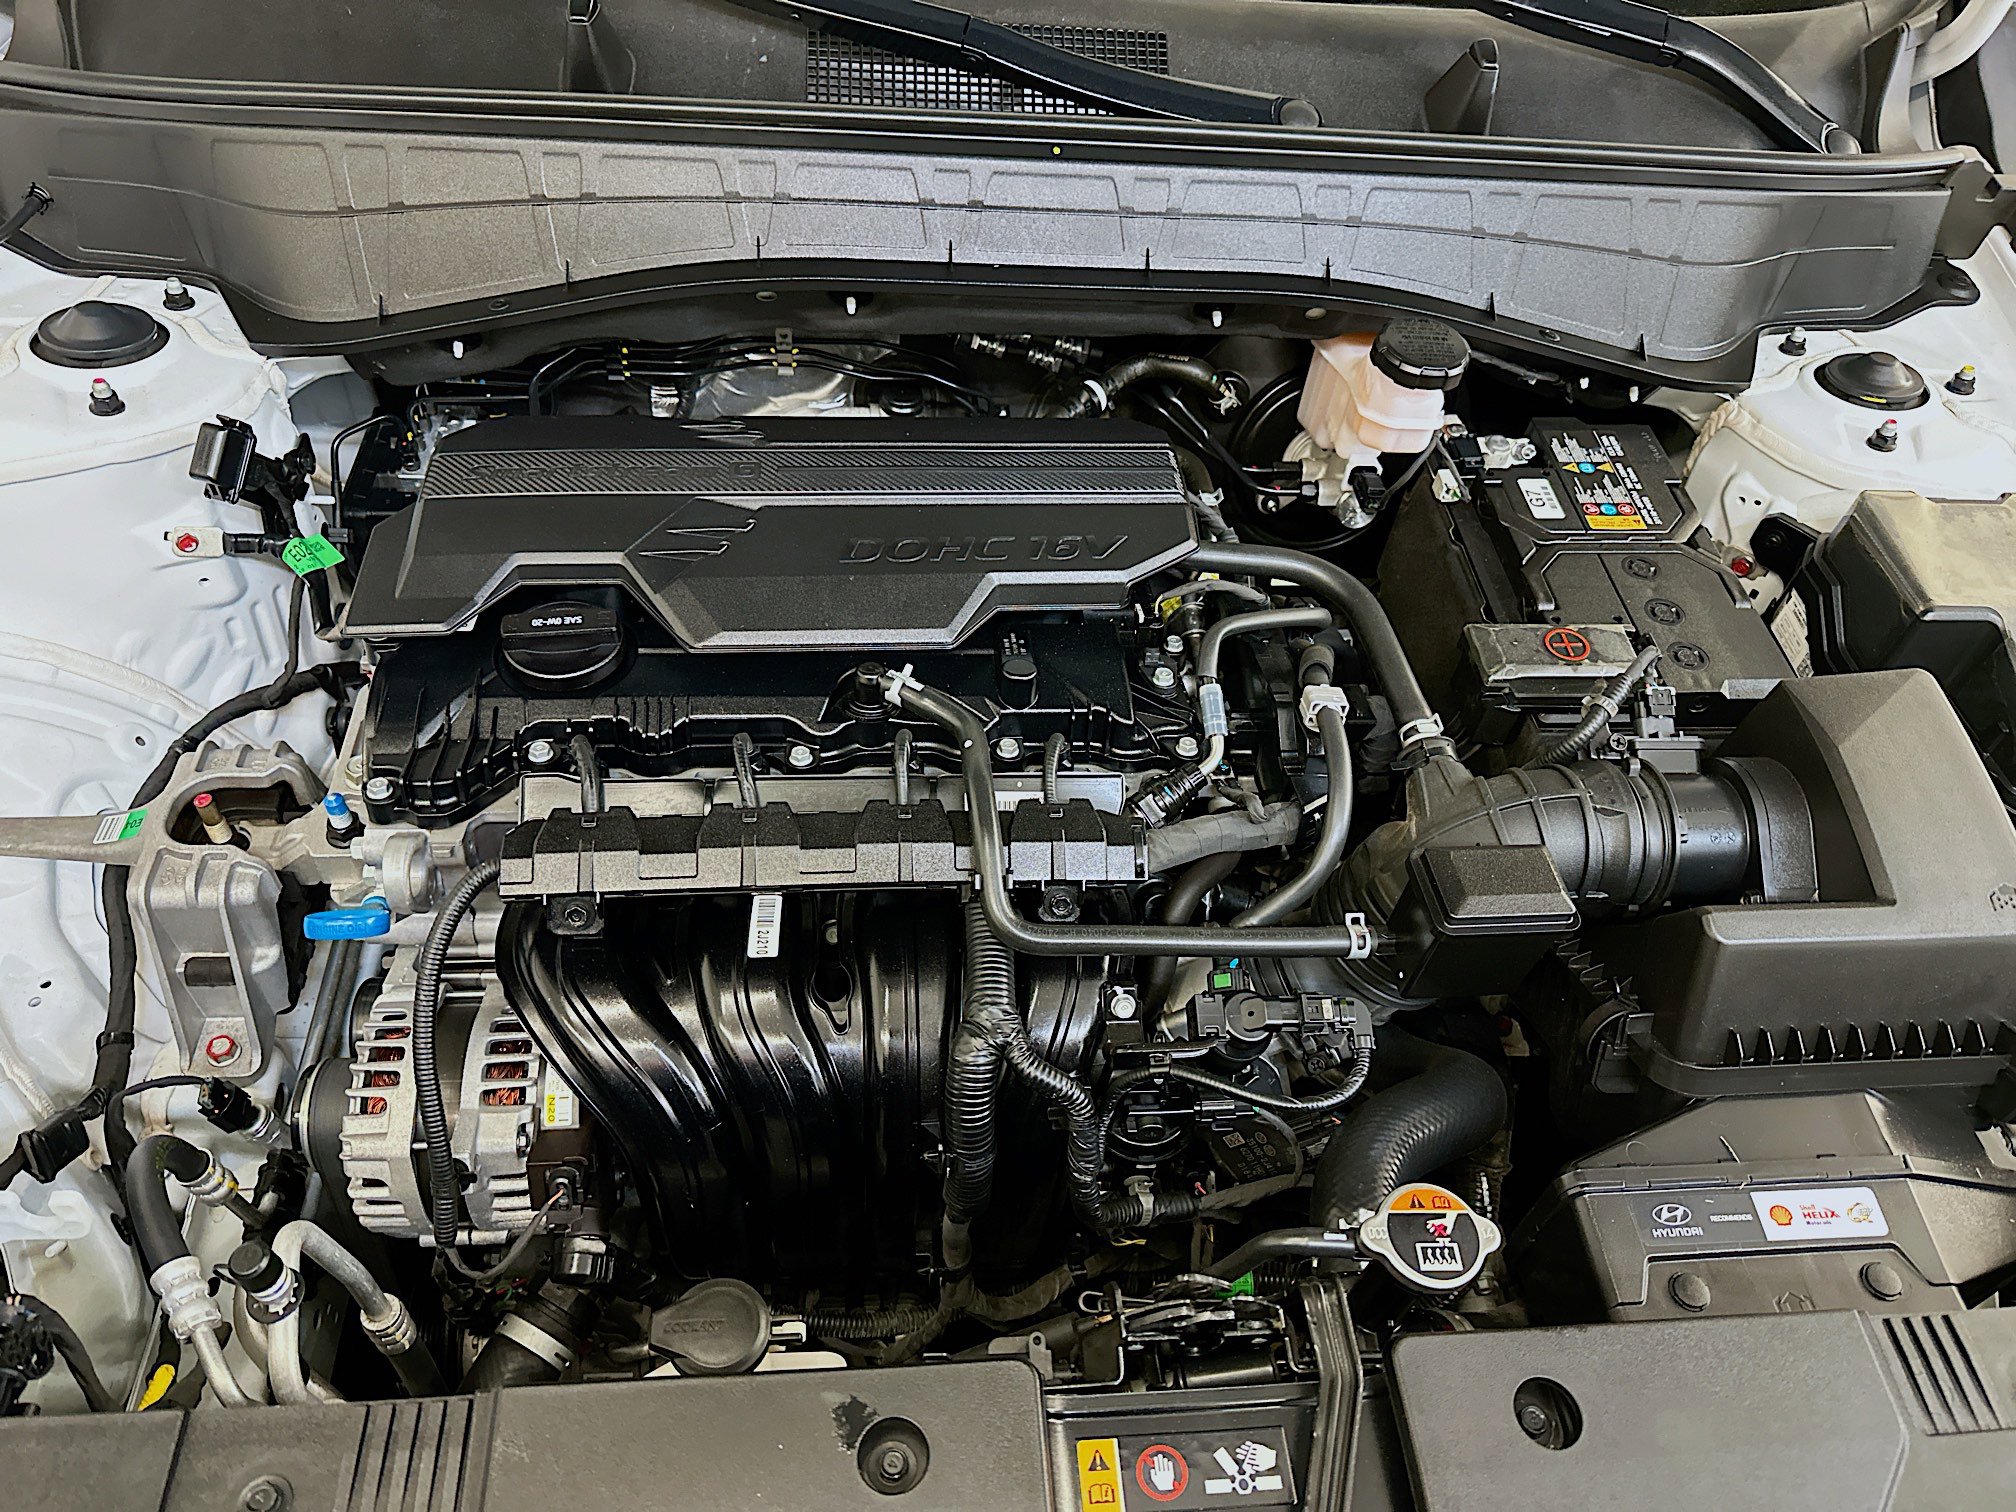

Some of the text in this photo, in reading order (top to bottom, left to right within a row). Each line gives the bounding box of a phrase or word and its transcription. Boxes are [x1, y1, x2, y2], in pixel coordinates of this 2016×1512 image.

[839, 534, 1129, 563] DOHC 16V
[531, 615, 583, 627] SAE 0W-20
[310, 923, 345, 935] ENGINE
[756, 930, 770, 955] 2J210
[547, 1097, 556, 1122] N20
[1802, 1208, 1840, 1219] HELIX
[1652, 1213, 1754, 1238] HYUNDAI RECOMMENDS
[663, 1318, 724, 1335] COOLANT
